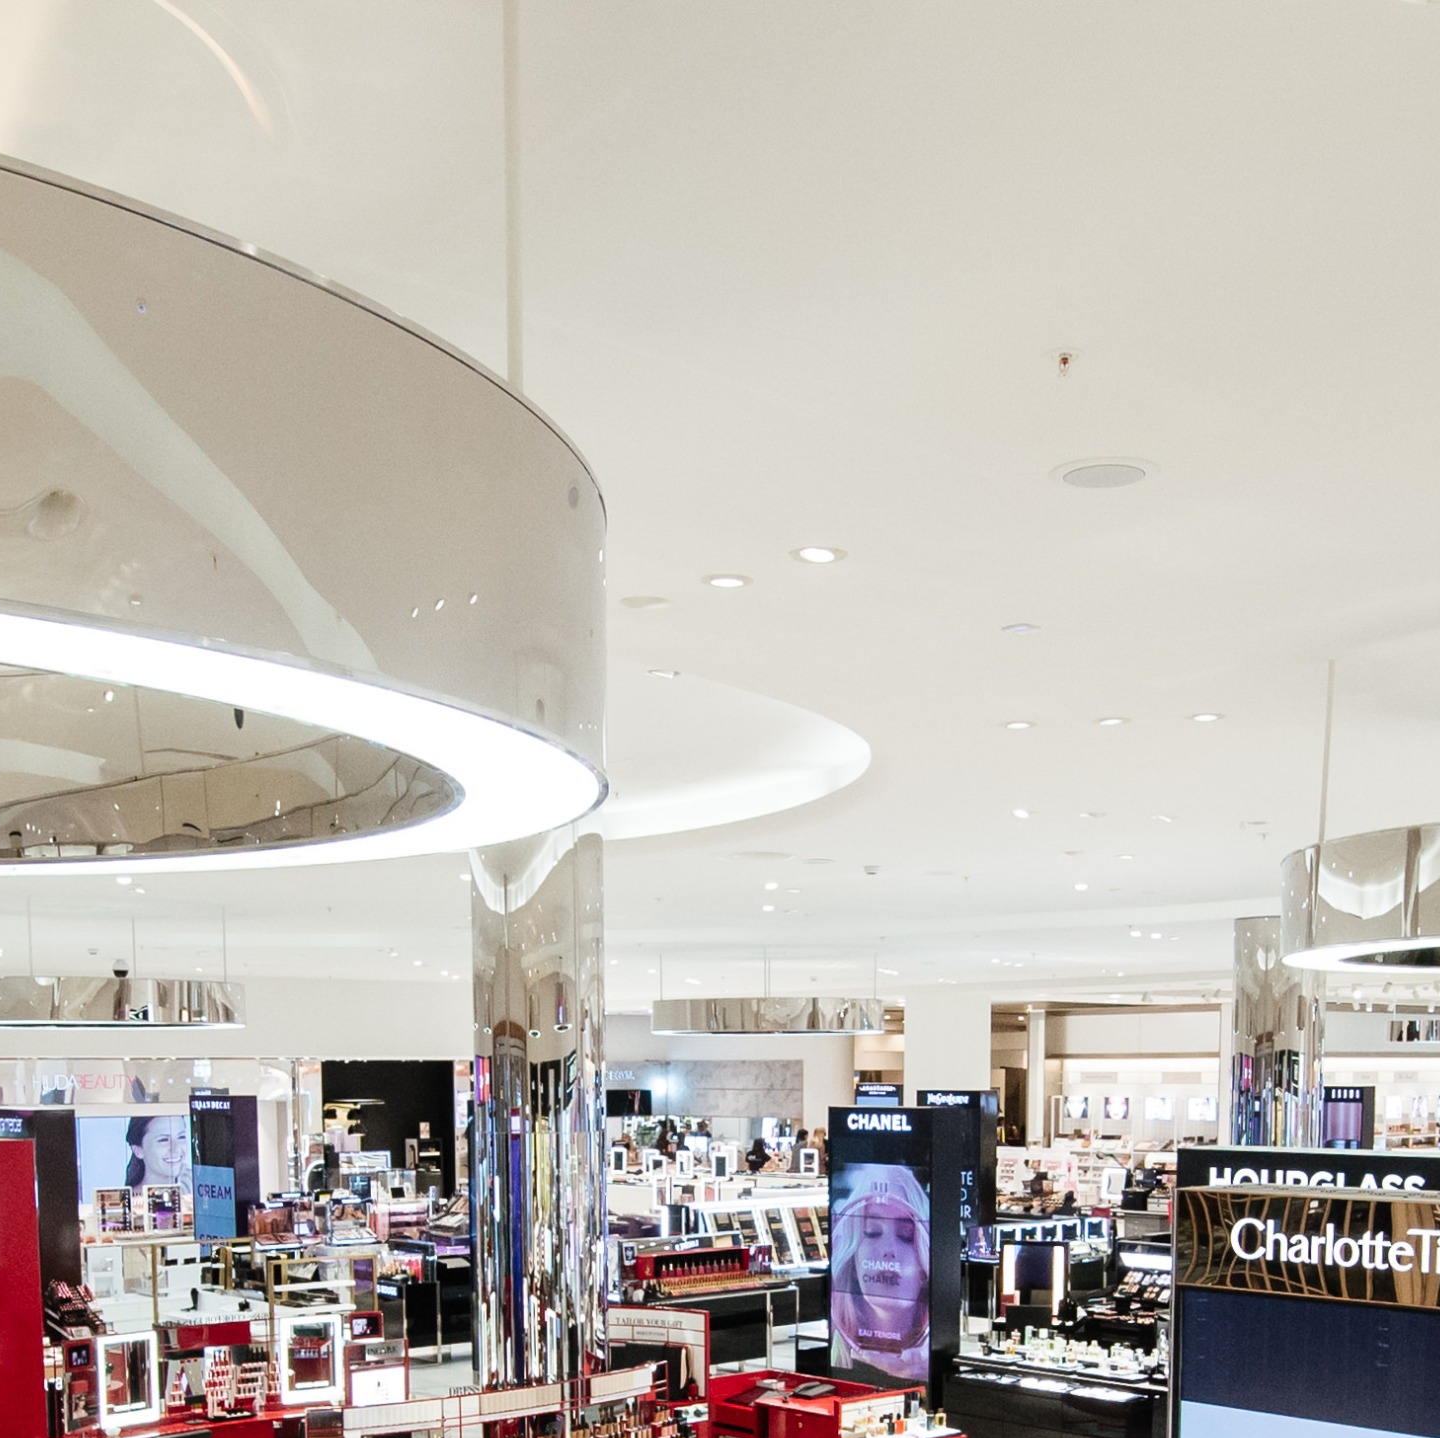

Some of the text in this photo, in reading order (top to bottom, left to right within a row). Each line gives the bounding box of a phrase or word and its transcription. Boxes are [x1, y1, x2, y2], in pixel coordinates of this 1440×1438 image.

[847, 1114, 912, 1131] CHANEL
[197, 1184, 233, 1200] CREAM
[862, 1260, 901, 1272] CHANCE
[862, 1274, 901, 1286] CHANEL
[858, 1329, 873, 1337] EAU
